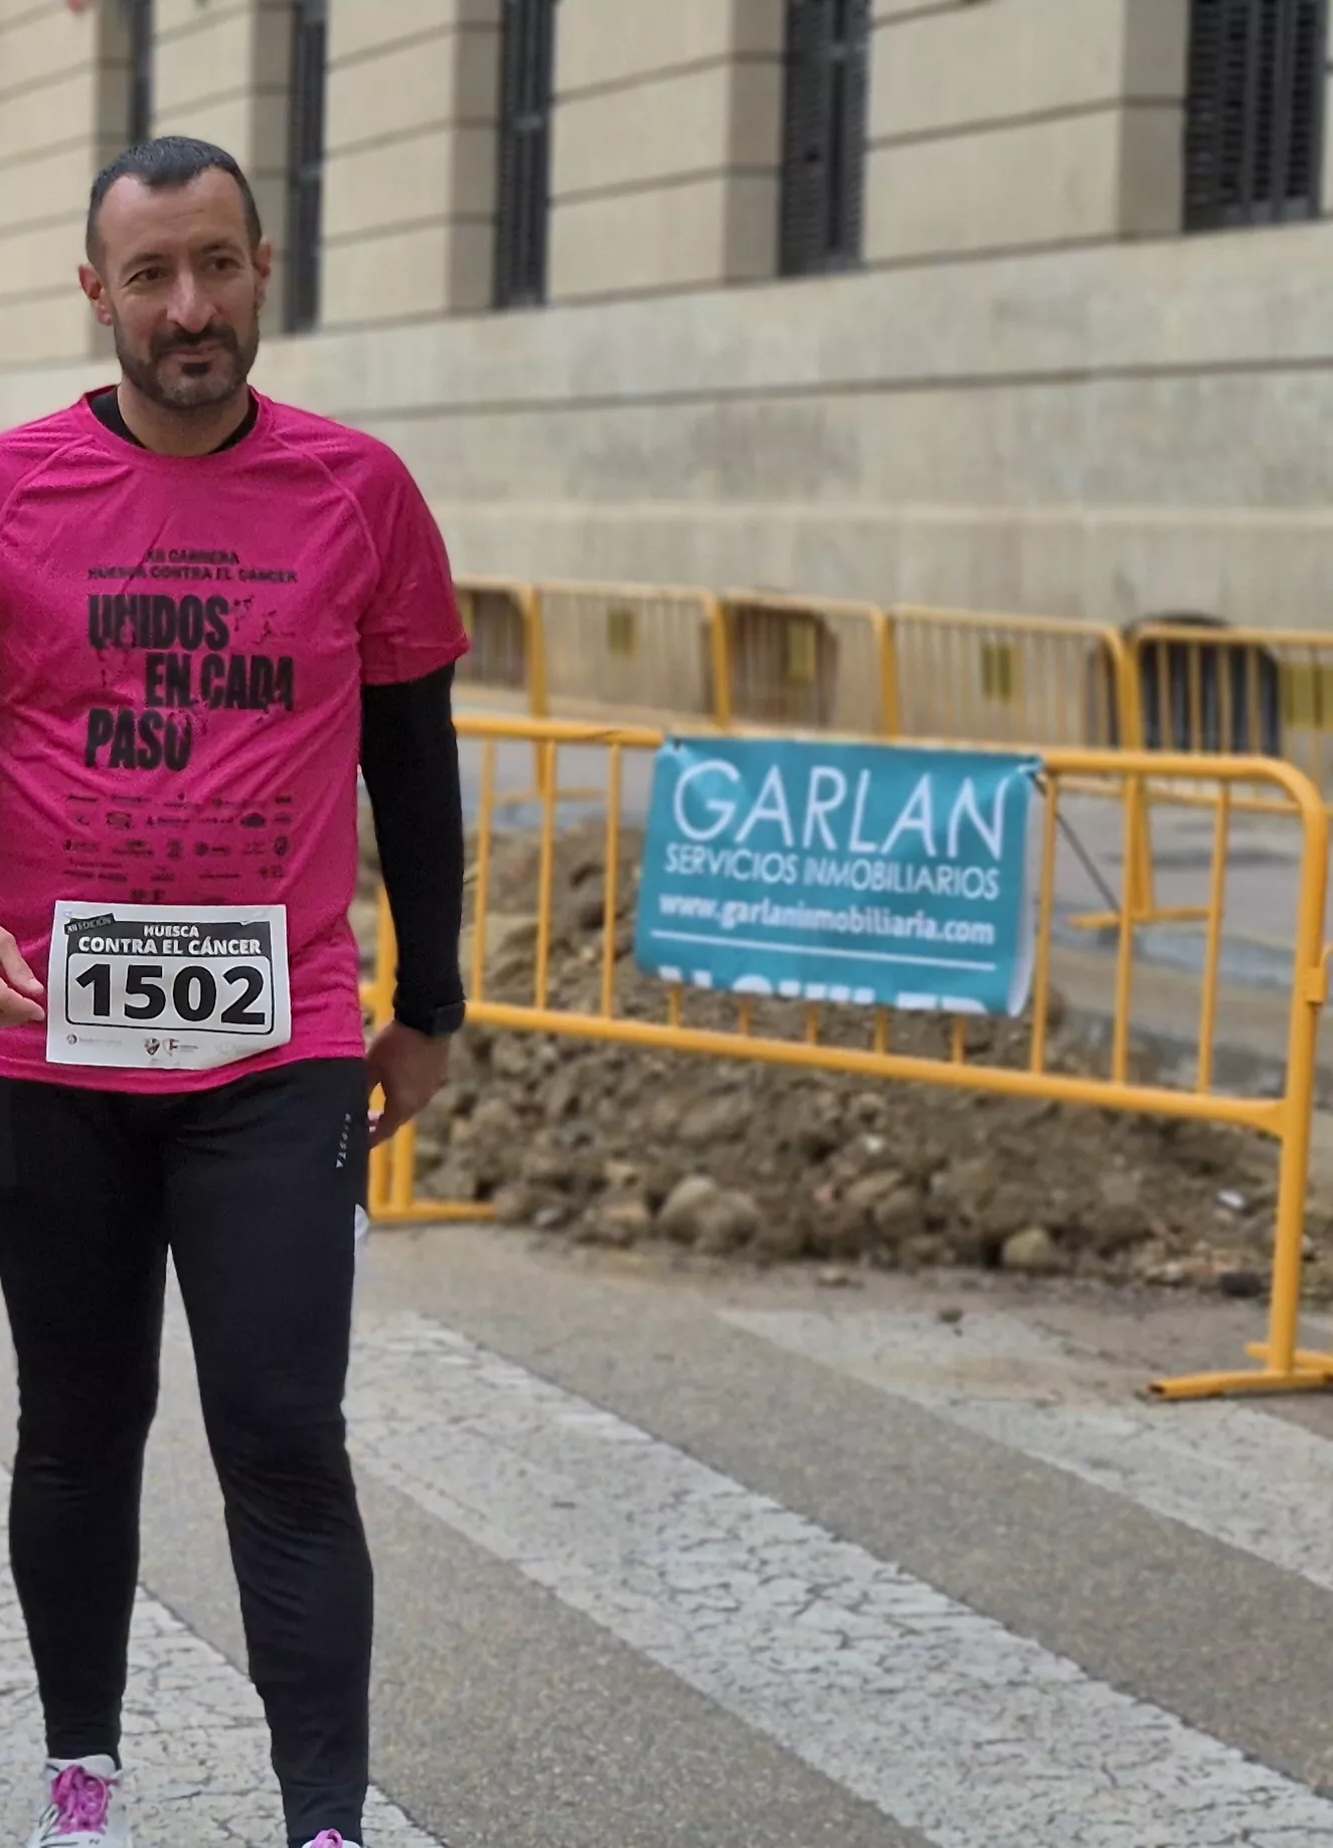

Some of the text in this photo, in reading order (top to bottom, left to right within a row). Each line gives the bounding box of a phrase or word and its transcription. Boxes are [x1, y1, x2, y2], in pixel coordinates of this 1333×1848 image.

[88, 566, 147, 579] HUESCA
[150, 566, 212, 580] CONTRA
[216, 567, 232, 580] EL
[169, 550, 239, 564] CARRERA
[88, 594, 230, 651] UNIDOS
[145, 652, 294, 710] EN CADA
[85, 707, 193, 771] PASO
[673, 759, 1011, 861] GARLAN
[665, 843, 1001, 901] SERVICIOS INMOBILIARIOS
[78, 936, 262, 956] CONTRA EL CÁNCER
[143, 924, 200, 938] HUESCA
[658, 892, 997, 948] www.garlaninmobiliaria.com
[75, 963, 266, 1025] 1502
